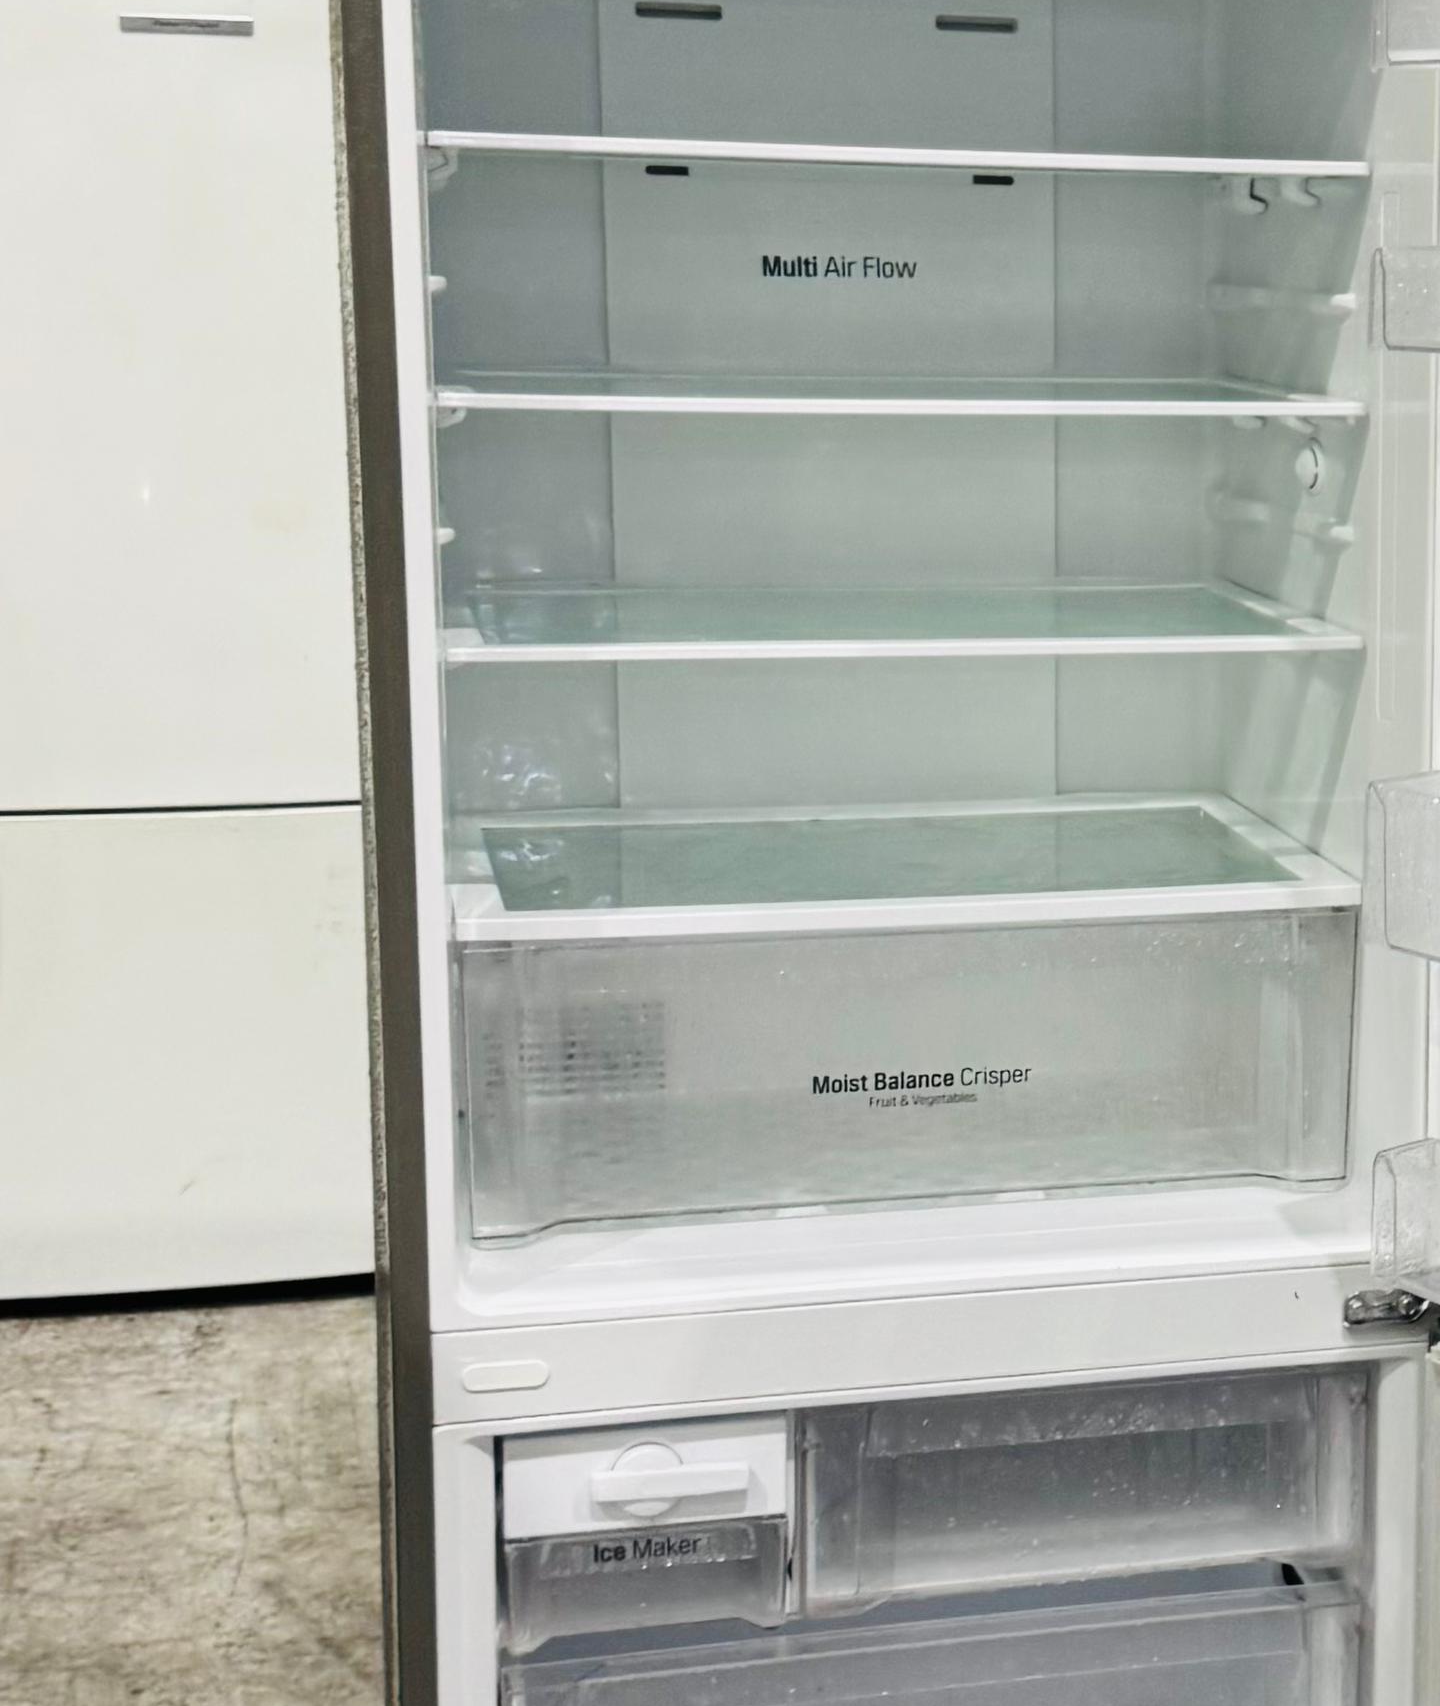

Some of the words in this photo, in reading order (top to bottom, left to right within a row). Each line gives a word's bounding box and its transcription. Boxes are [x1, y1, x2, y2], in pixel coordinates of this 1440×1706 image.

[762, 255, 818, 278] Multi
[824, 255, 857, 278] Air
[863, 256, 917, 279] Flow
[812, 1075, 869, 1095] Moist
[874, 1071, 955, 1092] Balance
[960, 1066, 1033, 1088] Crisper
[593, 1543, 627, 1563] Ice
[632, 1536, 702, 1560] Maker
